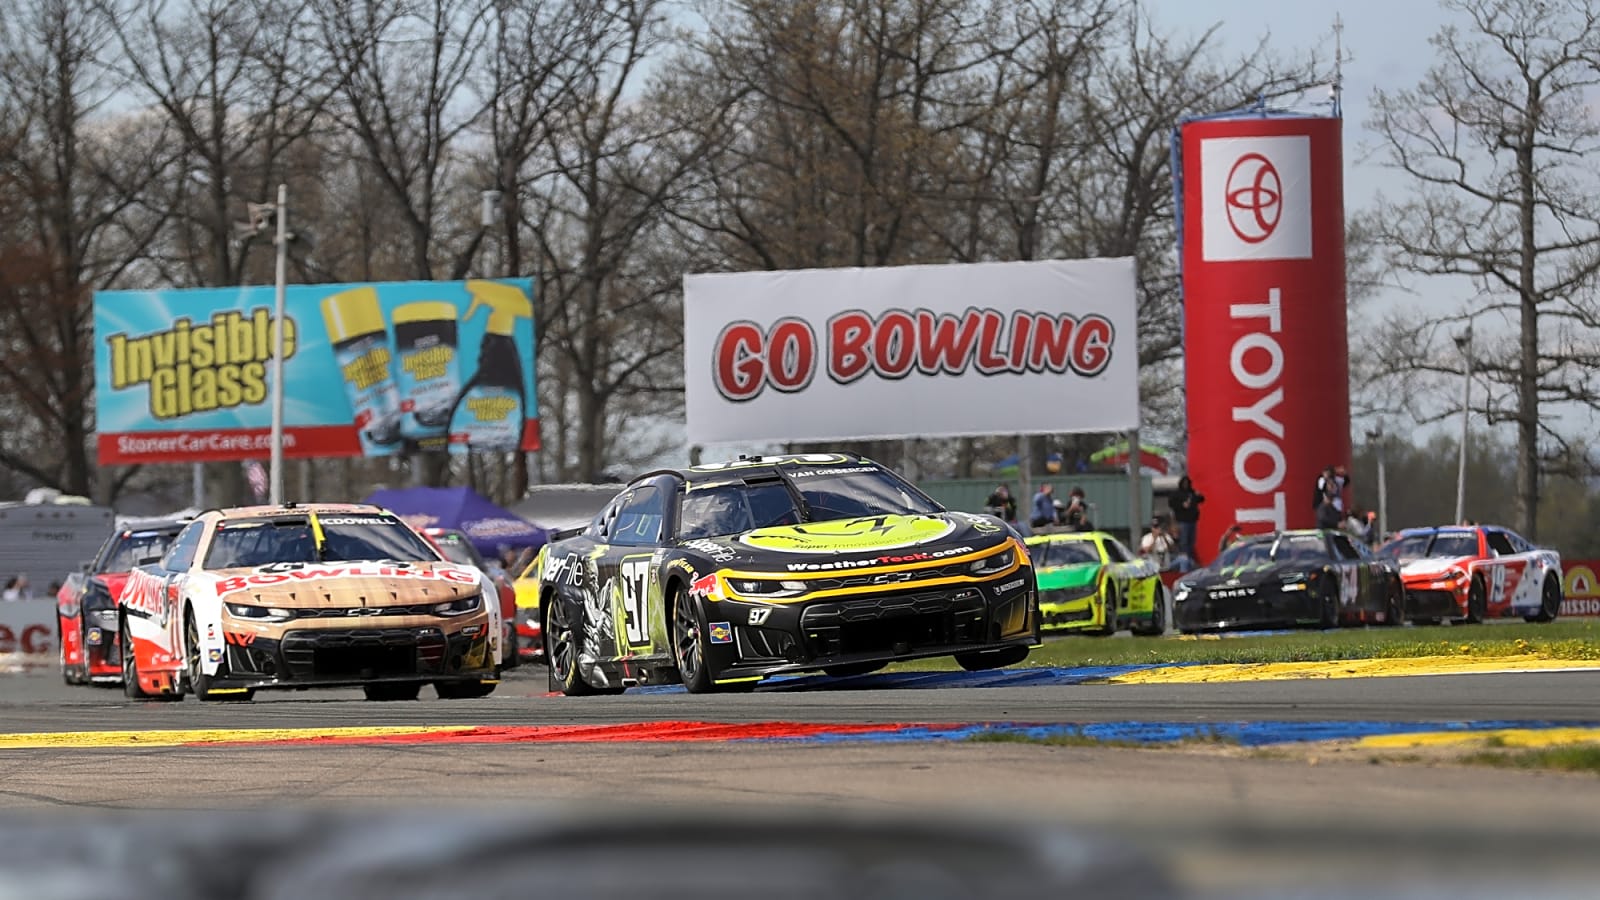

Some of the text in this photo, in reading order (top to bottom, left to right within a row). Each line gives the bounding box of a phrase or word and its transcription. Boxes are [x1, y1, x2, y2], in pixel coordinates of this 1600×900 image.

[107, 307, 296, 389] Invisible
[713, 307, 1115, 401] GO BOWLING
[151, 361, 267, 419] Glass
[1230, 288, 1287, 532] TOYOT
[118, 434, 295, 453] StonerCarCare.com
[216, 567, 474, 596] BOWLING
[787, 546, 974, 571] WeatherTech.com
[622, 560, 650, 643] 97
[749, 609, 771, 625] 97
